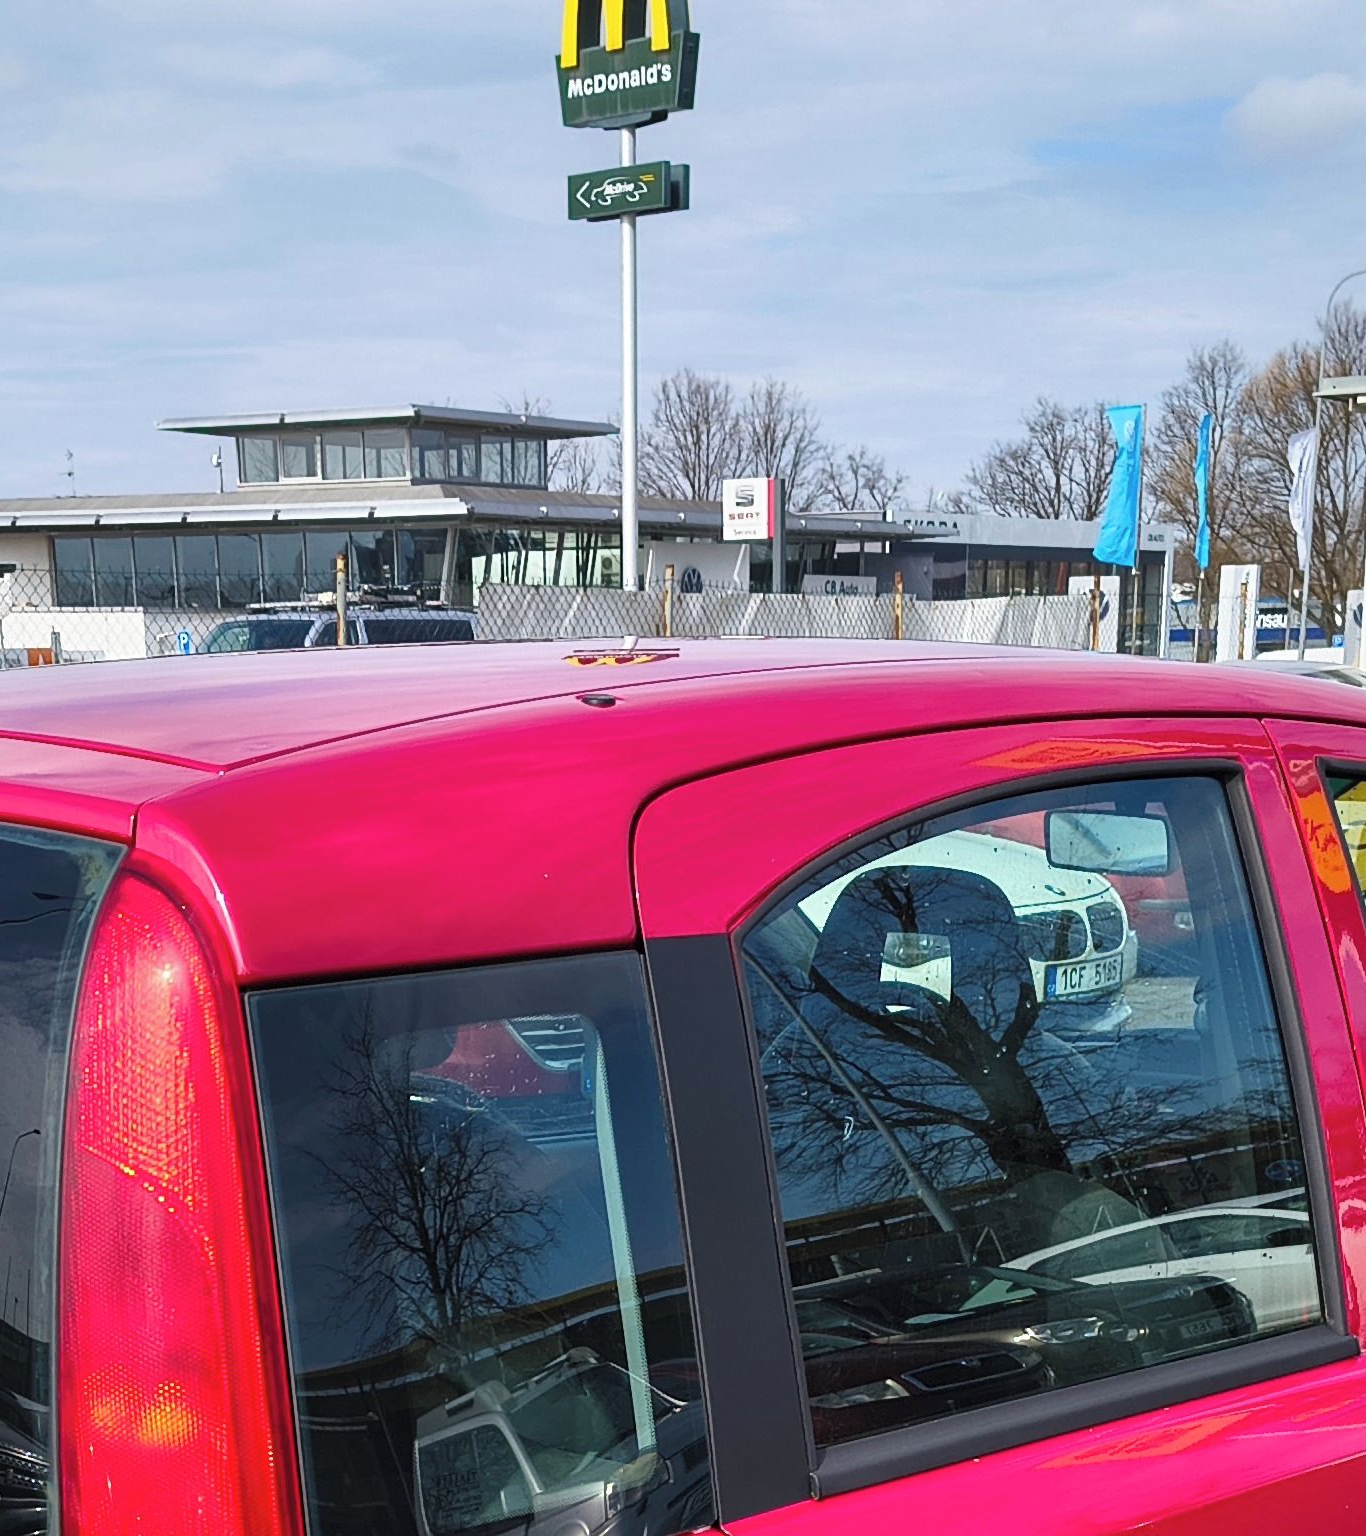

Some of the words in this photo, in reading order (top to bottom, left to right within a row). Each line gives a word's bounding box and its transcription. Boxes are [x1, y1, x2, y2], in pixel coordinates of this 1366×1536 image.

[567, 63, 672, 99] McDonald's
[728, 511, 761, 521] SEAT
[1061, 966, 1087, 991] 1CF
